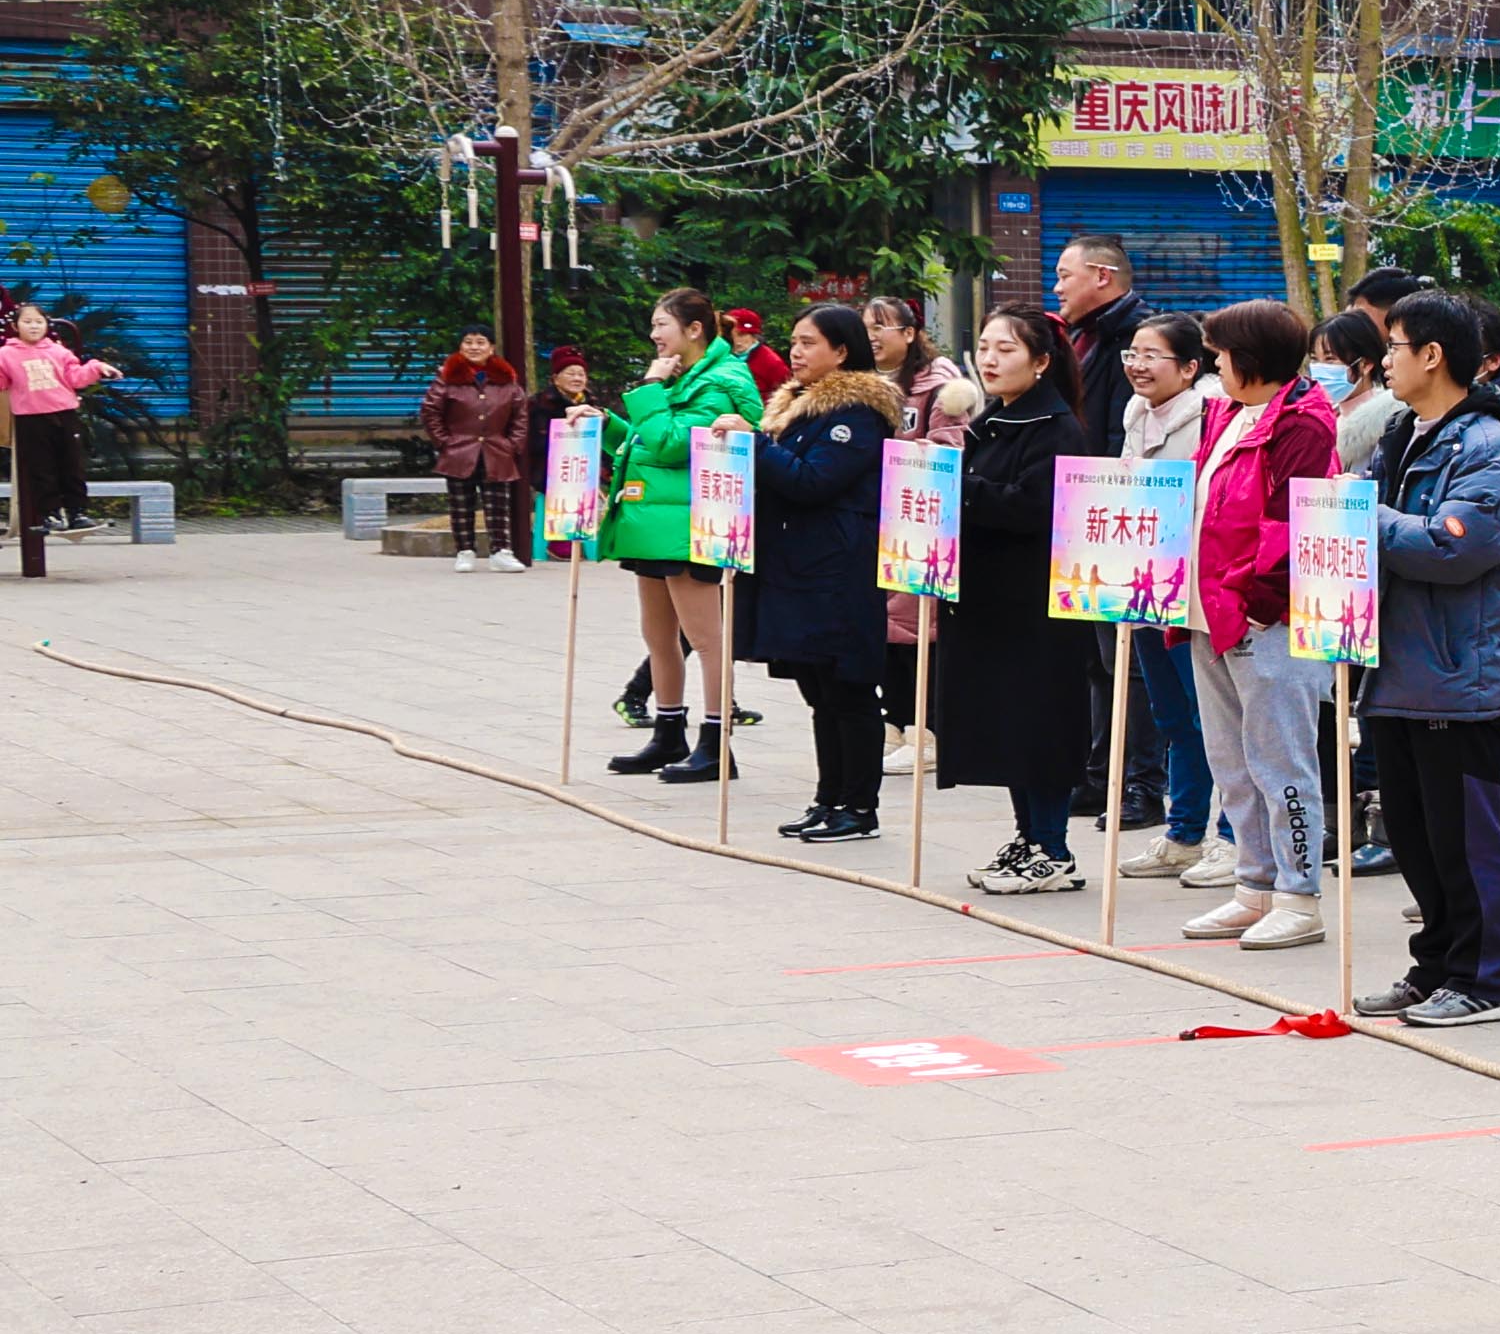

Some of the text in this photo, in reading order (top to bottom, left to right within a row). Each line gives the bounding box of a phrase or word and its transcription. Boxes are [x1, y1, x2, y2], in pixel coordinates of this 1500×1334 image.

[1074, 80, 1303, 136] 重庆风味小
[699, 469, 744, 507] 雷家河村
[900, 487, 942, 526] 黄金村
[1085, 505, 1160, 547] 新木村
[1298, 534, 1369, 581] 杨柳坝社区
[1283, 784, 1308, 856] adidas
